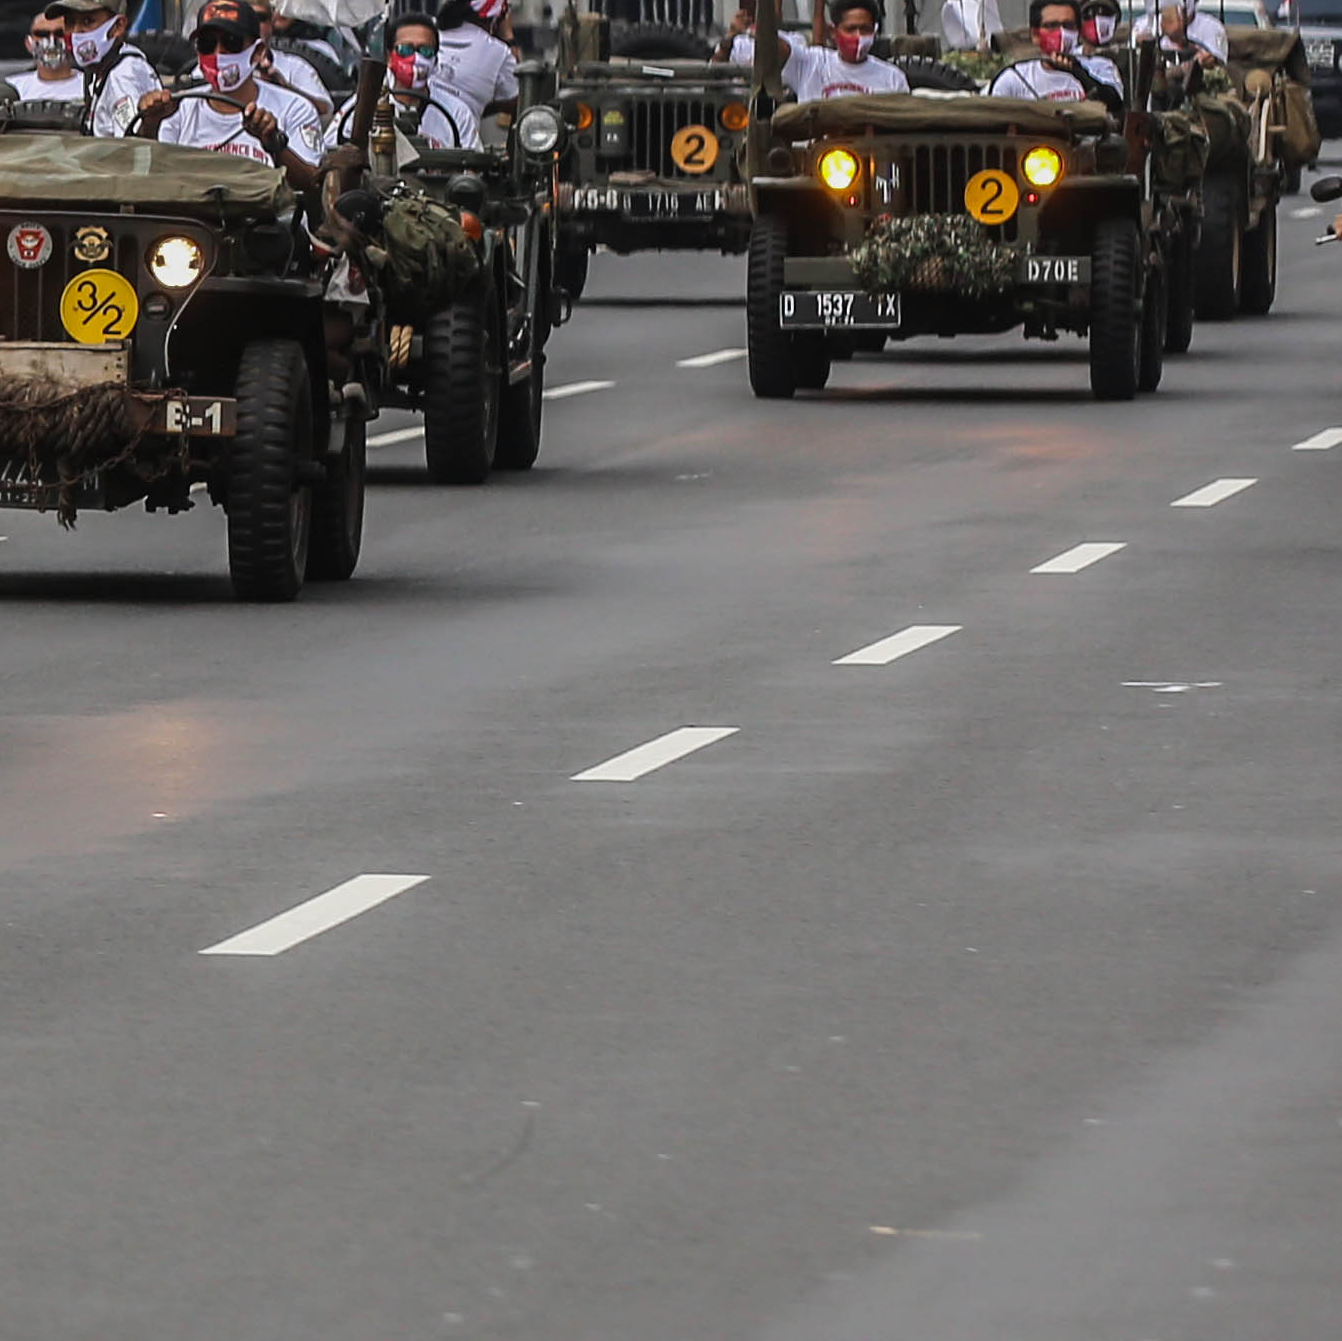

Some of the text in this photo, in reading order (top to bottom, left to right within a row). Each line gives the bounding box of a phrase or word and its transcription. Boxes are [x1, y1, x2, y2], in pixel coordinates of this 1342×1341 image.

[683, 134, 706, 165] 2
[981, 178, 1004, 214] 2
[784, 294, 795, 317] D
[817, 293, 854, 317] 1537
